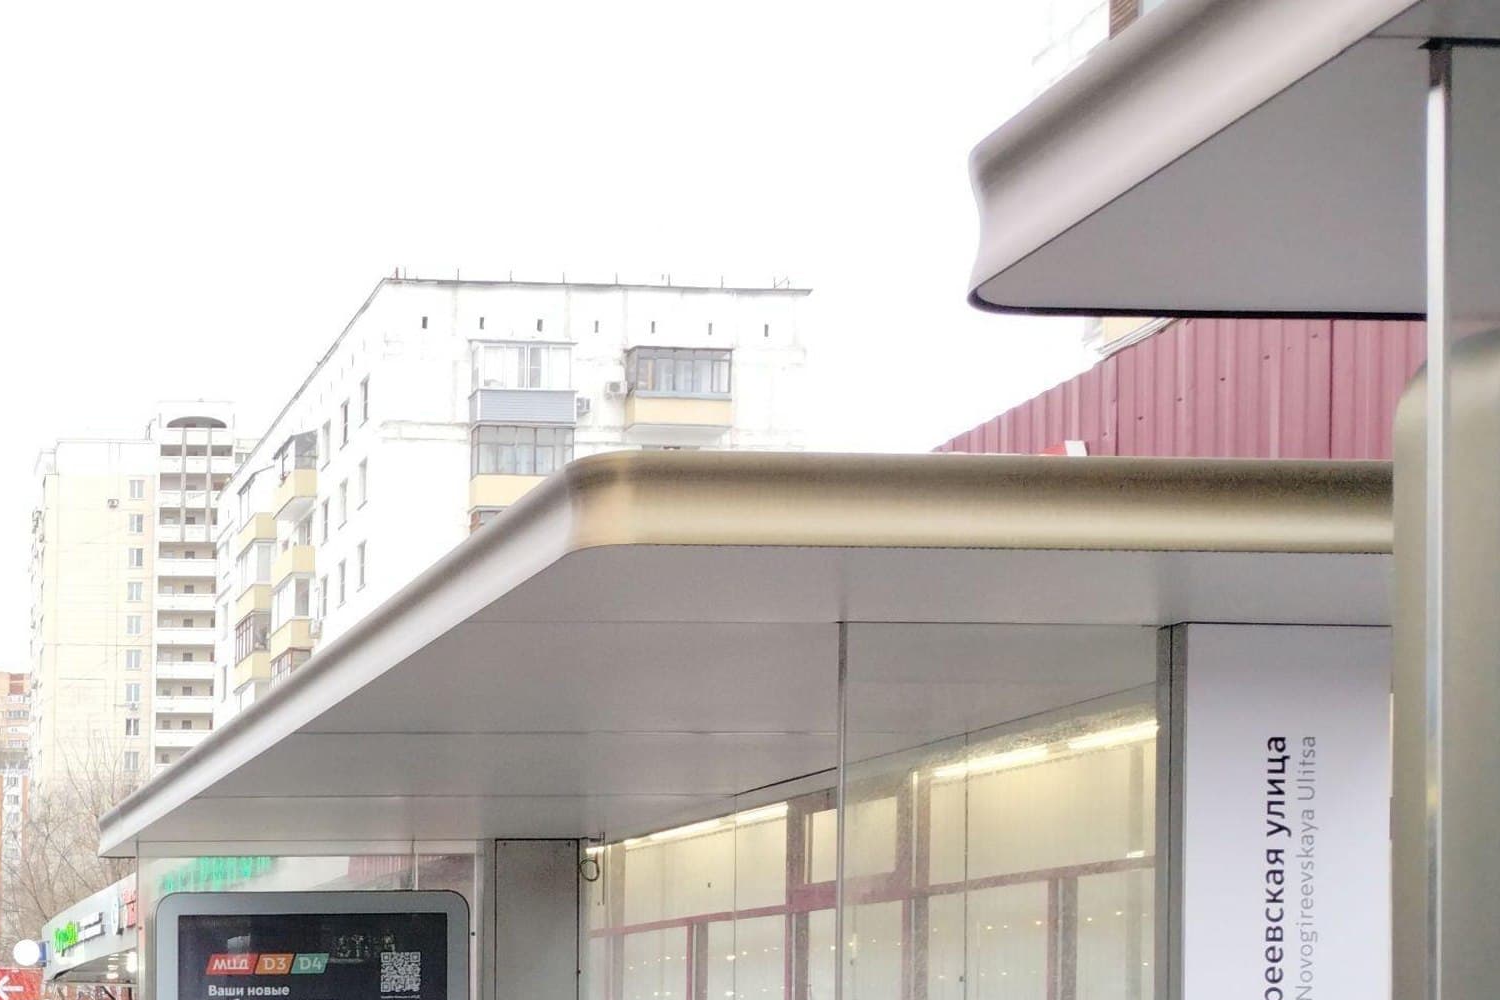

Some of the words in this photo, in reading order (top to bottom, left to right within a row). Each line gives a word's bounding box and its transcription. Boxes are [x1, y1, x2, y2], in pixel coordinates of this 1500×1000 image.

[1266, 736, 1292, 838] улица
[1296, 736, 1316, 800] Ulitsa
[1295, 808, 1319, 1000] Novogireevskaya
[207, 984, 244, 997] Ваши
[247, 985, 290, 996] новые
[212, 957, 250, 971] МЦД
[263, 957, 286, 971] D3
[298, 956, 323, 971] D4
